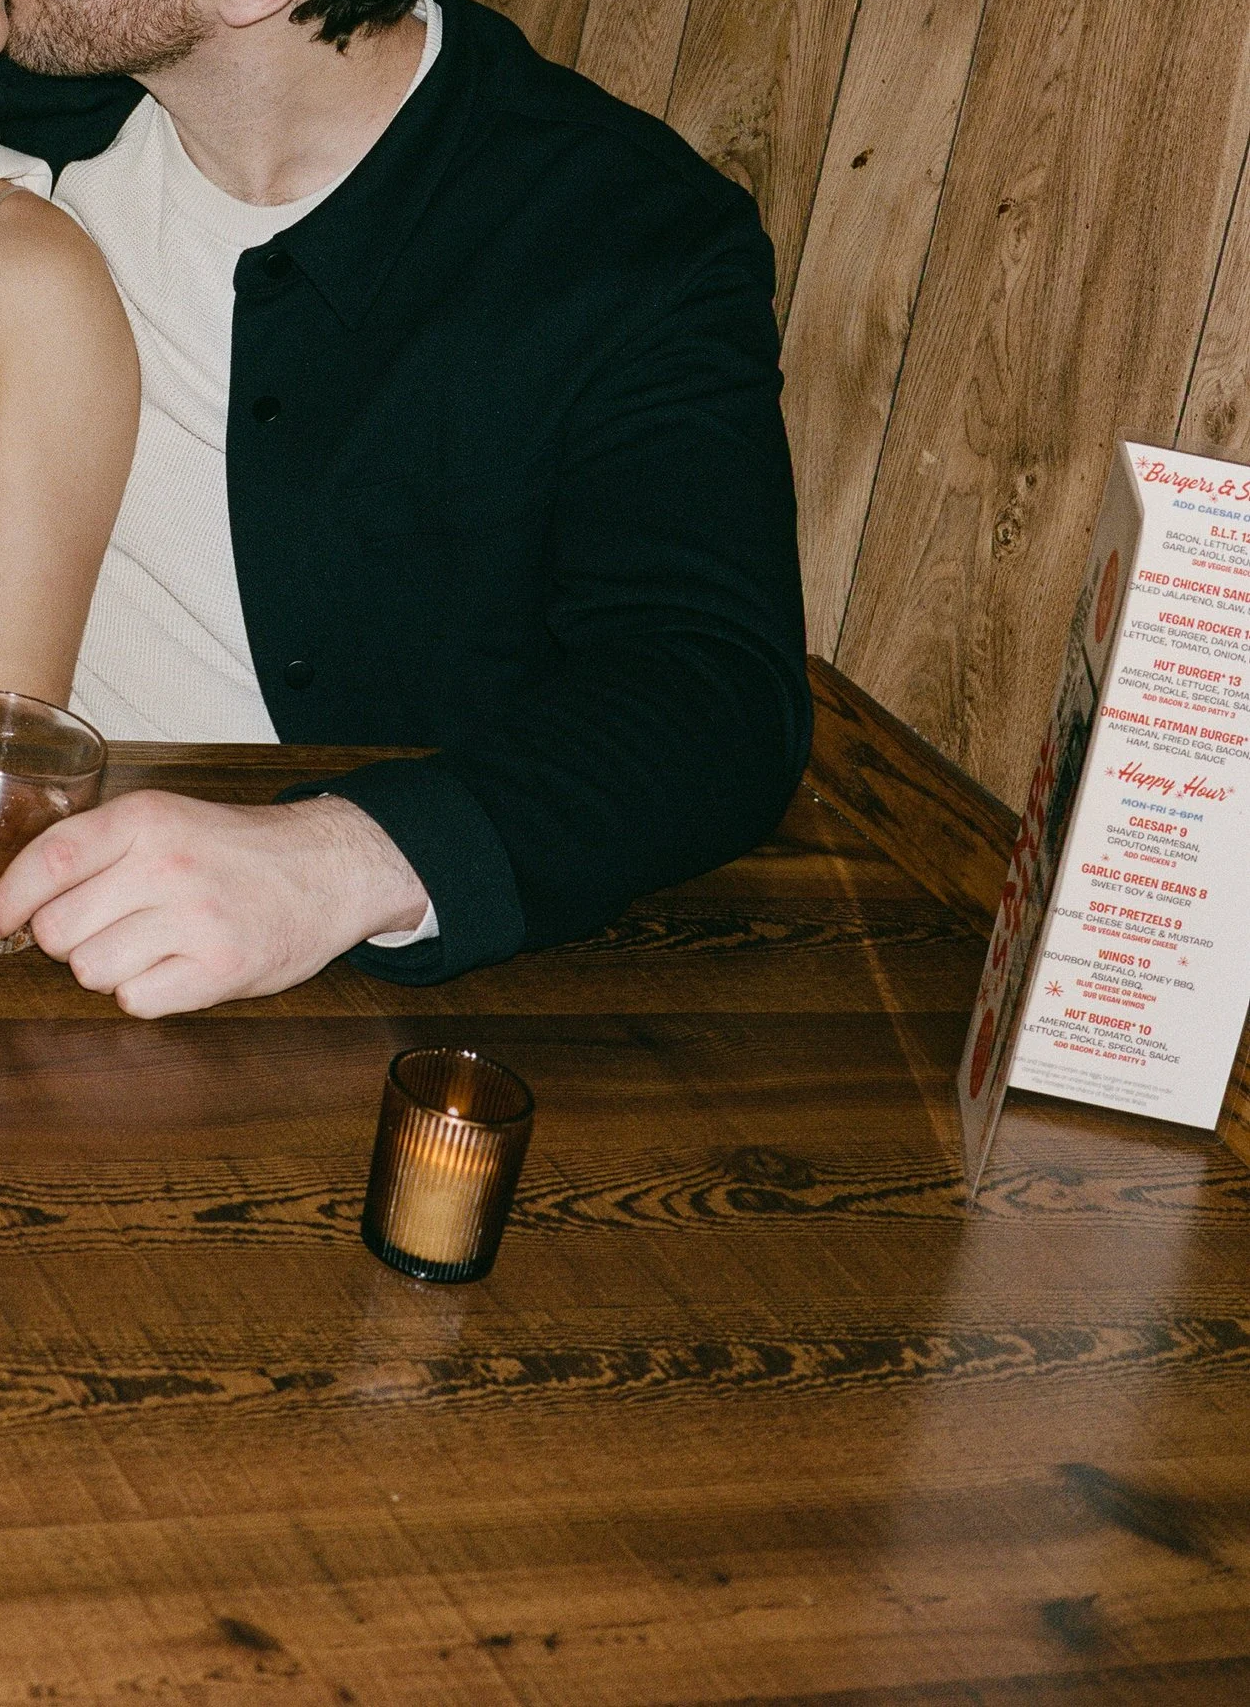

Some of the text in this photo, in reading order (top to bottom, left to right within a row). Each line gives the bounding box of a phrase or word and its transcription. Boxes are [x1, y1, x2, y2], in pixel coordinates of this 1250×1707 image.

[1144, 463, 1214, 493] Burgers
[1218, 480, 1236, 496] &
[1173, 499, 1195, 510] ADD
[1198, 504, 1241, 520] CAESAR
[1210, 526, 1237, 540] B.L.T.
[1162, 540, 1197, 555] GARLIC
[1192, 558, 1206, 567] SUB
[1208, 562, 1231, 573] VEGGIE
[1139, 569, 1169, 585] FRIED
[1172, 577, 1220, 596] CHICKEN
[1132, 620, 1165, 634] VEGGIE
[1211, 637, 1238, 650] DAIYA
[1159, 612, 1195, 628] VEGAN
[1197, 620, 1242, 638] ROCKER
[1154, 658, 1176, 672] HUT
[1229, 675, 1242, 687] 13
[1142, 692, 1156, 702] ADD
[1159, 696, 1183, 707] BACON
[1191, 704, 1206, 712] ADD
[1208, 707, 1229, 718] PATTY
[1192, 693, 1230, 708] SPECIAL
[1101, 706, 1150, 726] ORIGINAL
[1153, 718, 1198, 736] FATMAN
[1162, 733, 1190, 746] FRIED
[1153, 743, 1191, 758] SPECIAL
[1194, 752, 1226, 766] SAUCE
[1118, 761, 1228, 801] Happy Hour
[1121, 798, 1203, 822] MON-FRI 2-6PM
[1106, 825, 1145, 839] SHAVED
[1180, 827, 1187, 837] 9
[1124, 850, 1138, 859] ADD
[1140, 854, 1170, 866] CHICKEN
[1164, 849, 1198, 862] LEMON
[1081, 863, 1208, 900] GARLIC GREEN BEANS 8
[1091, 878, 1191, 908] SWEET SOY & GINGER
[1089, 901, 1182, 930] SOFT PRETZELS 9
[1082, 923, 1177, 950] SUB VEGAN CASHEW CHEESE
[1086, 913, 1122, 929] CHEESE
[1125, 922, 1156, 936] SAUCE
[1158, 930, 1165, 938] &
[1168, 932, 1213, 949] MUSTARD
[1044, 950, 1091, 967] BOURBON
[1139, 971, 1171, 985] HONEY
[1098, 949, 1151, 969] WINGS 10
[1091, 972, 1119, 984] ASIAN
[1076, 979, 1156, 1002] BLUE CHEESE OR RANCH
[1083, 990, 1145, 1010] SUB VEGAN WINGS
[1064, 1008, 1086, 1020] HUT
[1139, 1024, 1152, 1035] 10
[1053, 1040, 1069, 1049] ADD
[1069, 1043, 1093, 1054] BACON
[1102, 1051, 1116, 1059] ADD
[1118, 1054, 1139, 1065] PATTY
[1108, 1042, 1146, 1057] SPECIAL
[1149, 1051, 1180, 1064] SAUCE
